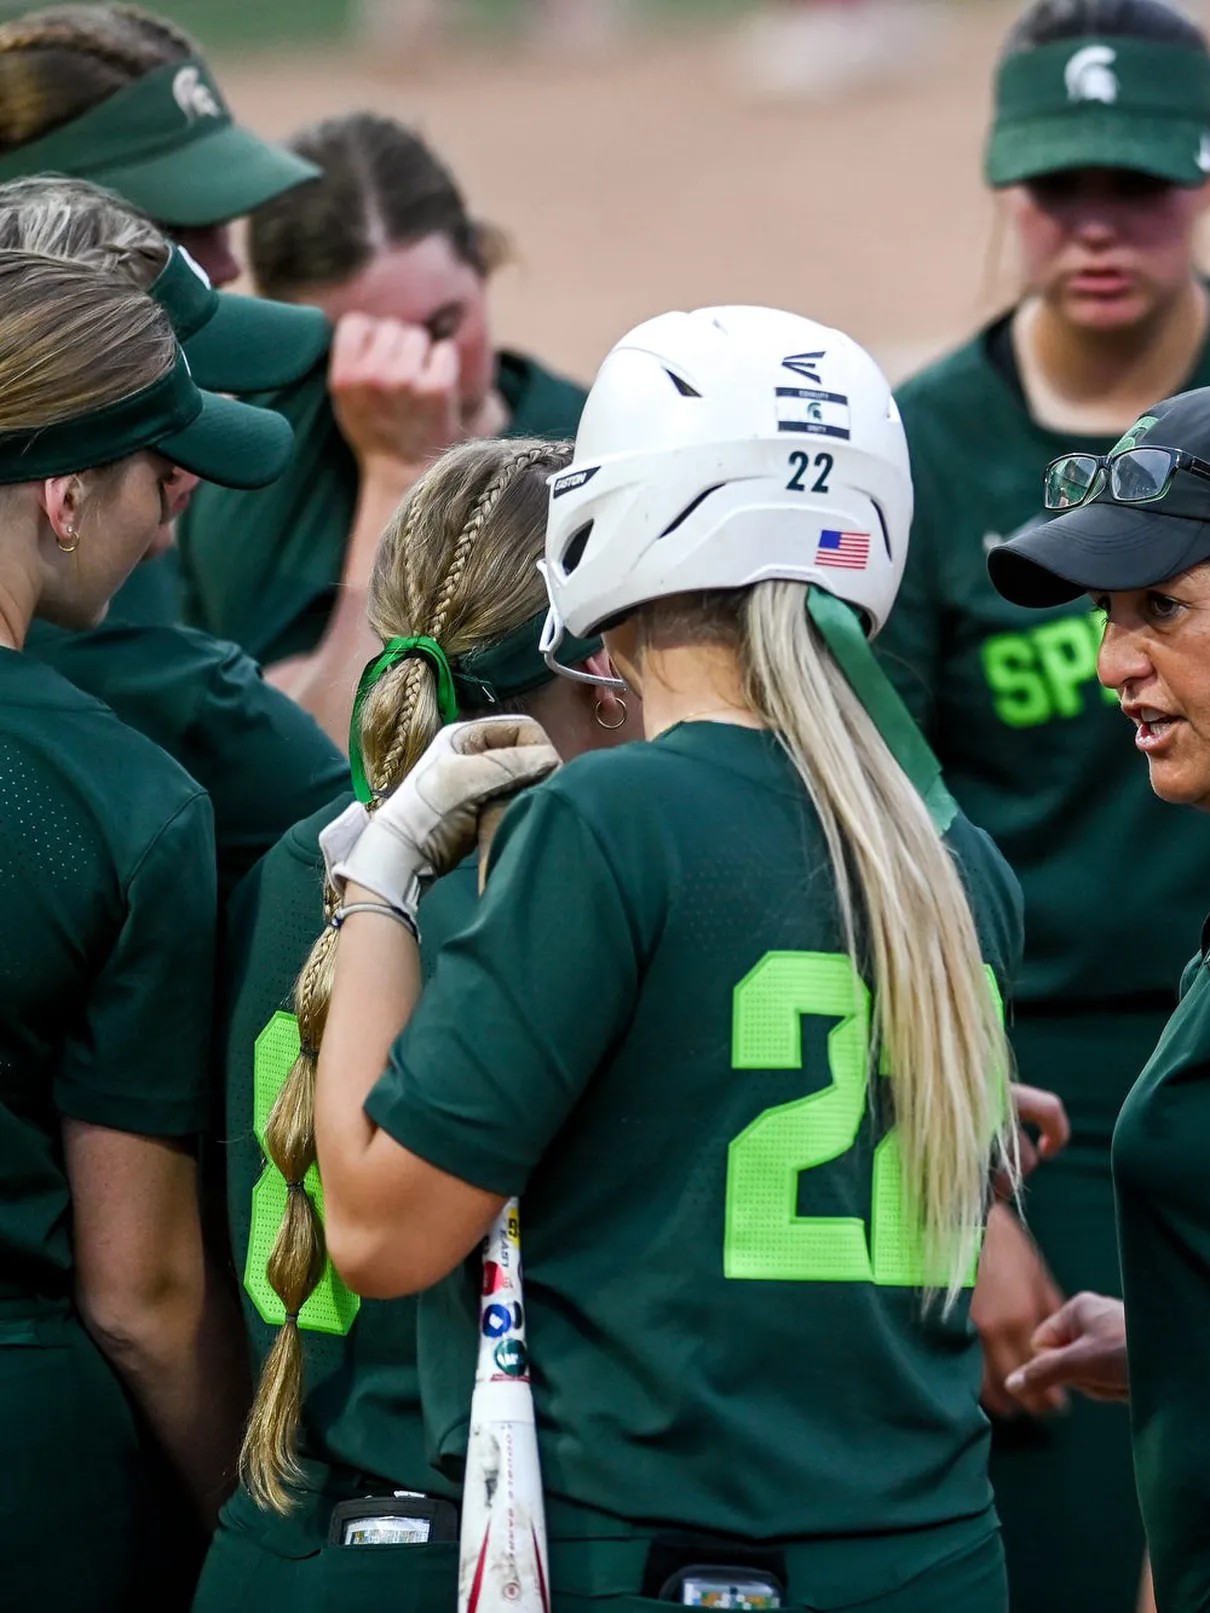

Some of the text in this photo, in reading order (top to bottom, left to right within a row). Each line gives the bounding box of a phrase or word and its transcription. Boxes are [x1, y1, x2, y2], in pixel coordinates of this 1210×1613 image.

[555, 472, 587, 491] EASTON
[786, 450, 834, 493] 22
[982, 608, 1112, 728] SP
